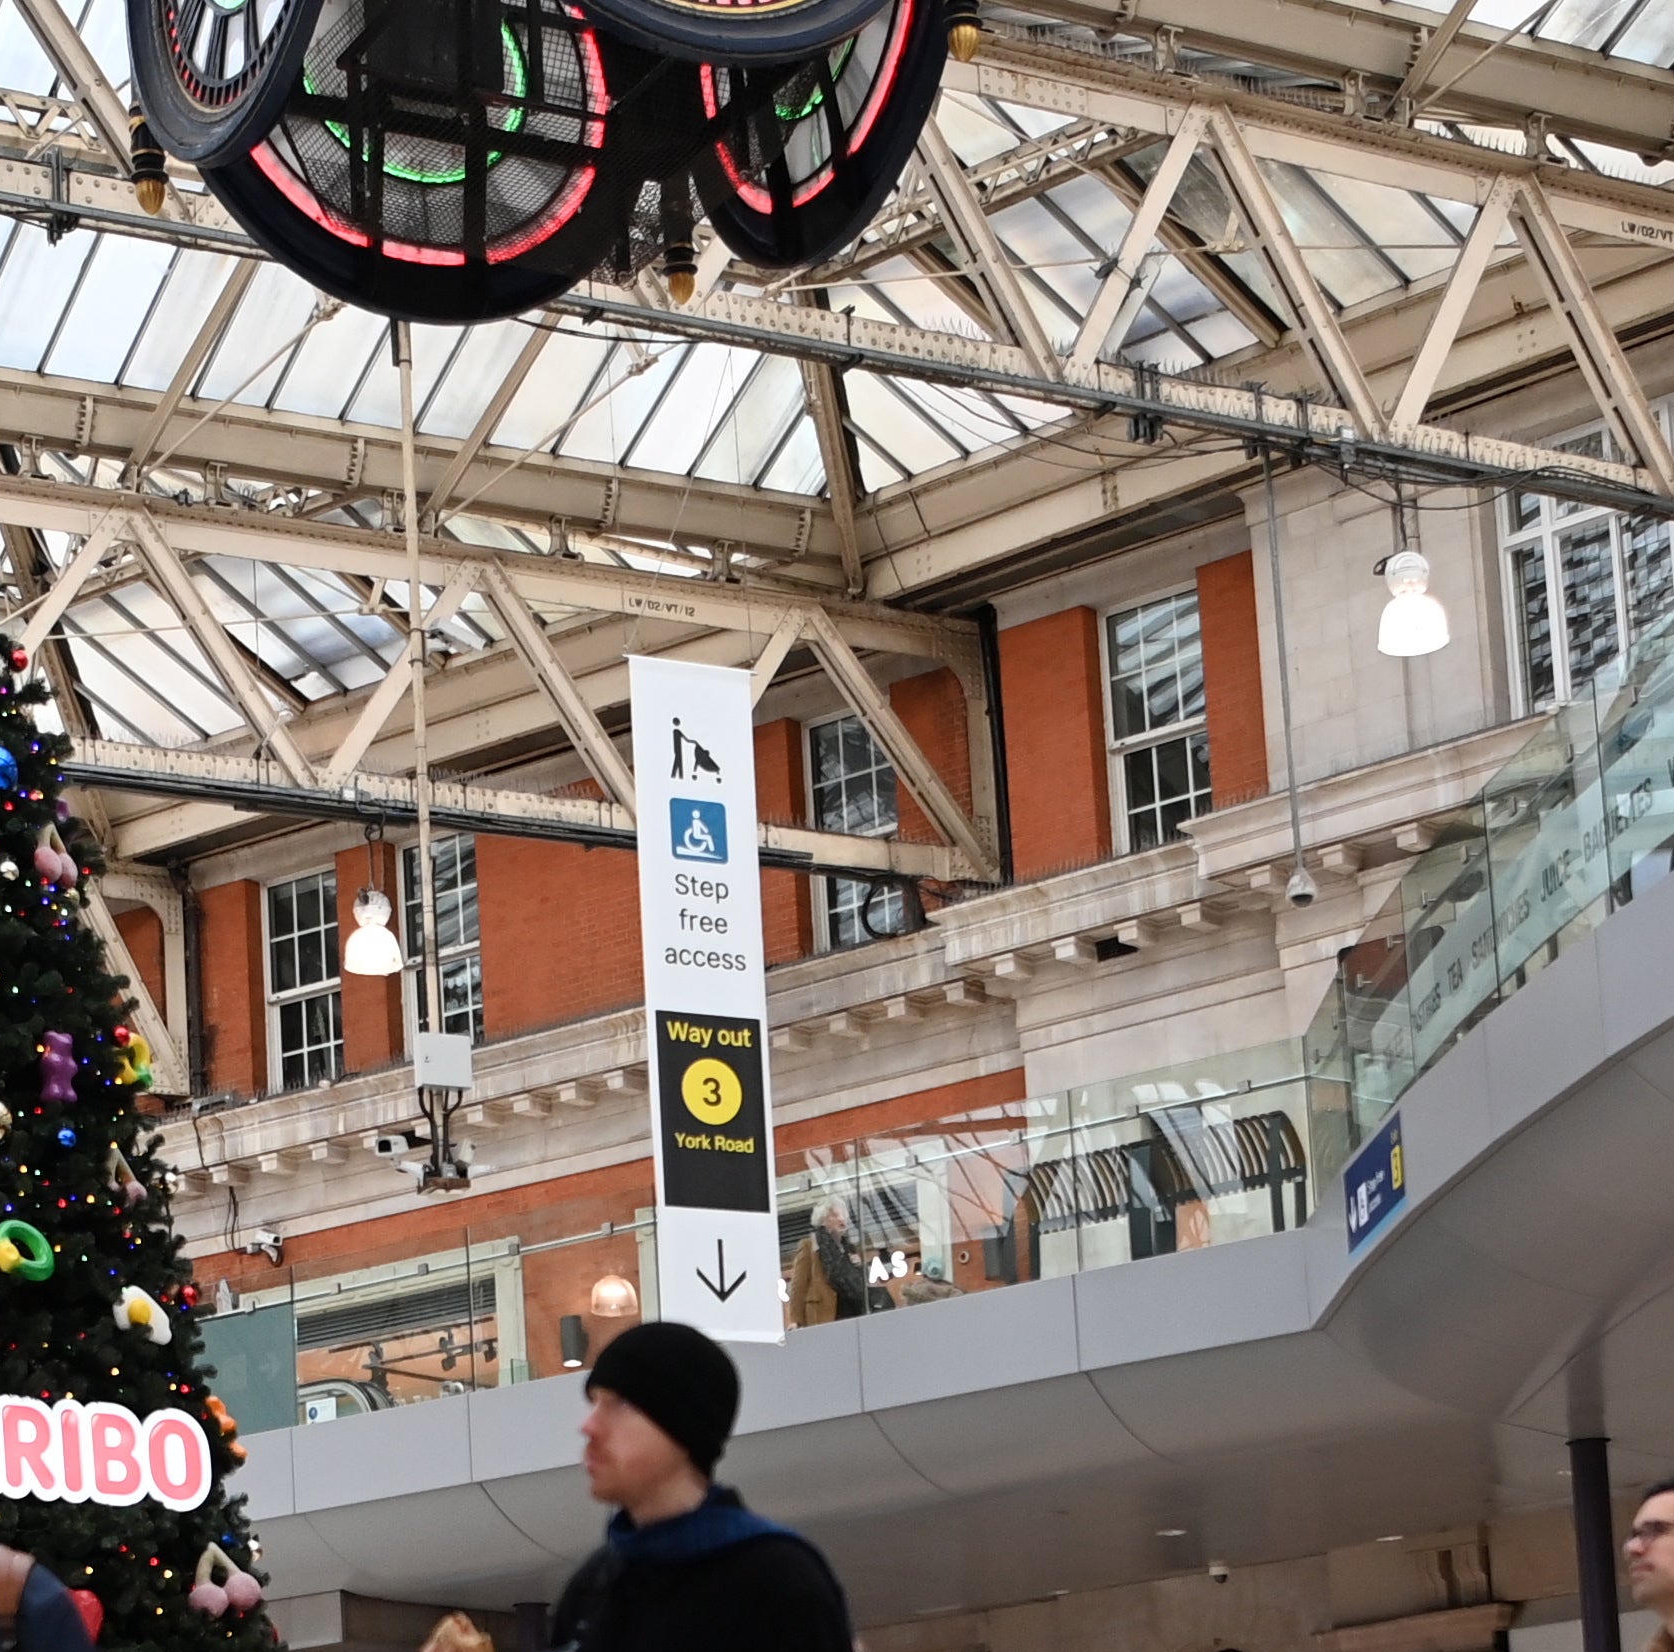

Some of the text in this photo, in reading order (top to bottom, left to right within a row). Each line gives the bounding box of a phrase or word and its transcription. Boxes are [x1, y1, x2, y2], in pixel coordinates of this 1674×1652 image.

[675, 873, 729, 904] Step
[679, 908, 728, 934] free
[665, 947, 747, 971] access
[666, 1021, 752, 1048] Way out
[703, 1078, 722, 1107] 3
[675, 1133, 754, 1153] York Road
